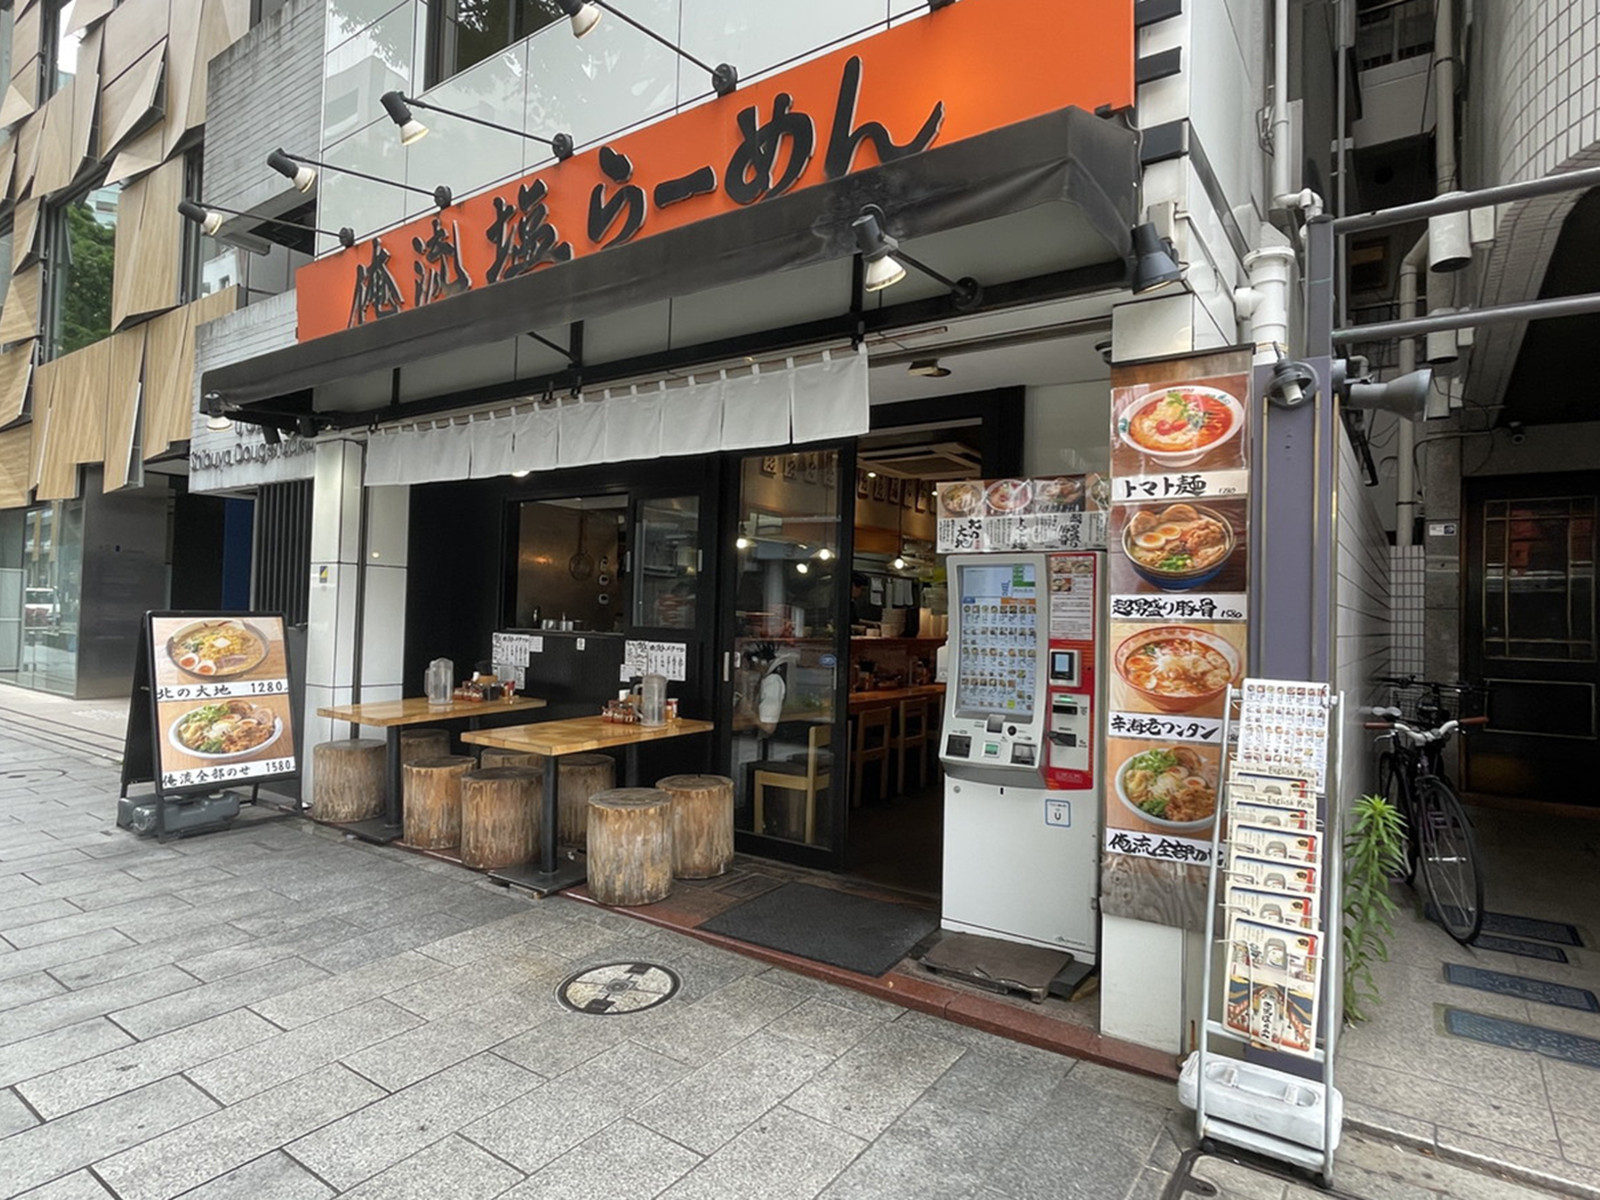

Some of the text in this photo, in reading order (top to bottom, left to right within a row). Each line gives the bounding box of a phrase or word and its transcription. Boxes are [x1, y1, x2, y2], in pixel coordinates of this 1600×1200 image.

[1124, 474, 1207, 498] トマト麺
[157, 684, 232, 699] 北の大地
